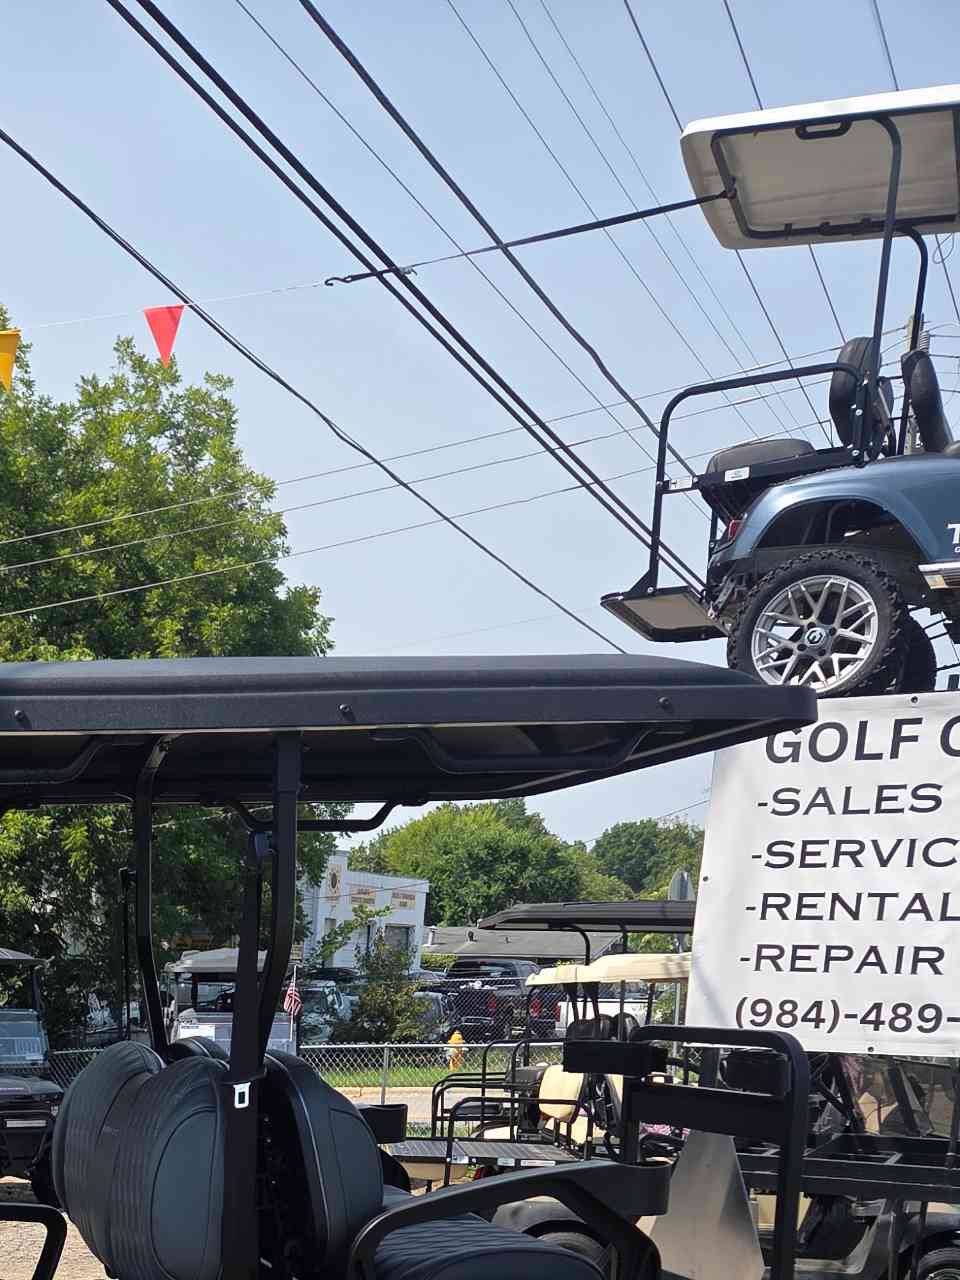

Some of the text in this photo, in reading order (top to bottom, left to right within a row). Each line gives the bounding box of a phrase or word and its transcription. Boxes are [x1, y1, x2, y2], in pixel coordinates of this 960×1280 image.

[765, 717, 924, 764] GOLF
[757, 783, 944, 817] -SALES
[745, 891, 960, 922] -RENTAL
[739, 943, 946, 976] -REPAIR
[735, 996, 960, 1034] (984)-489-
